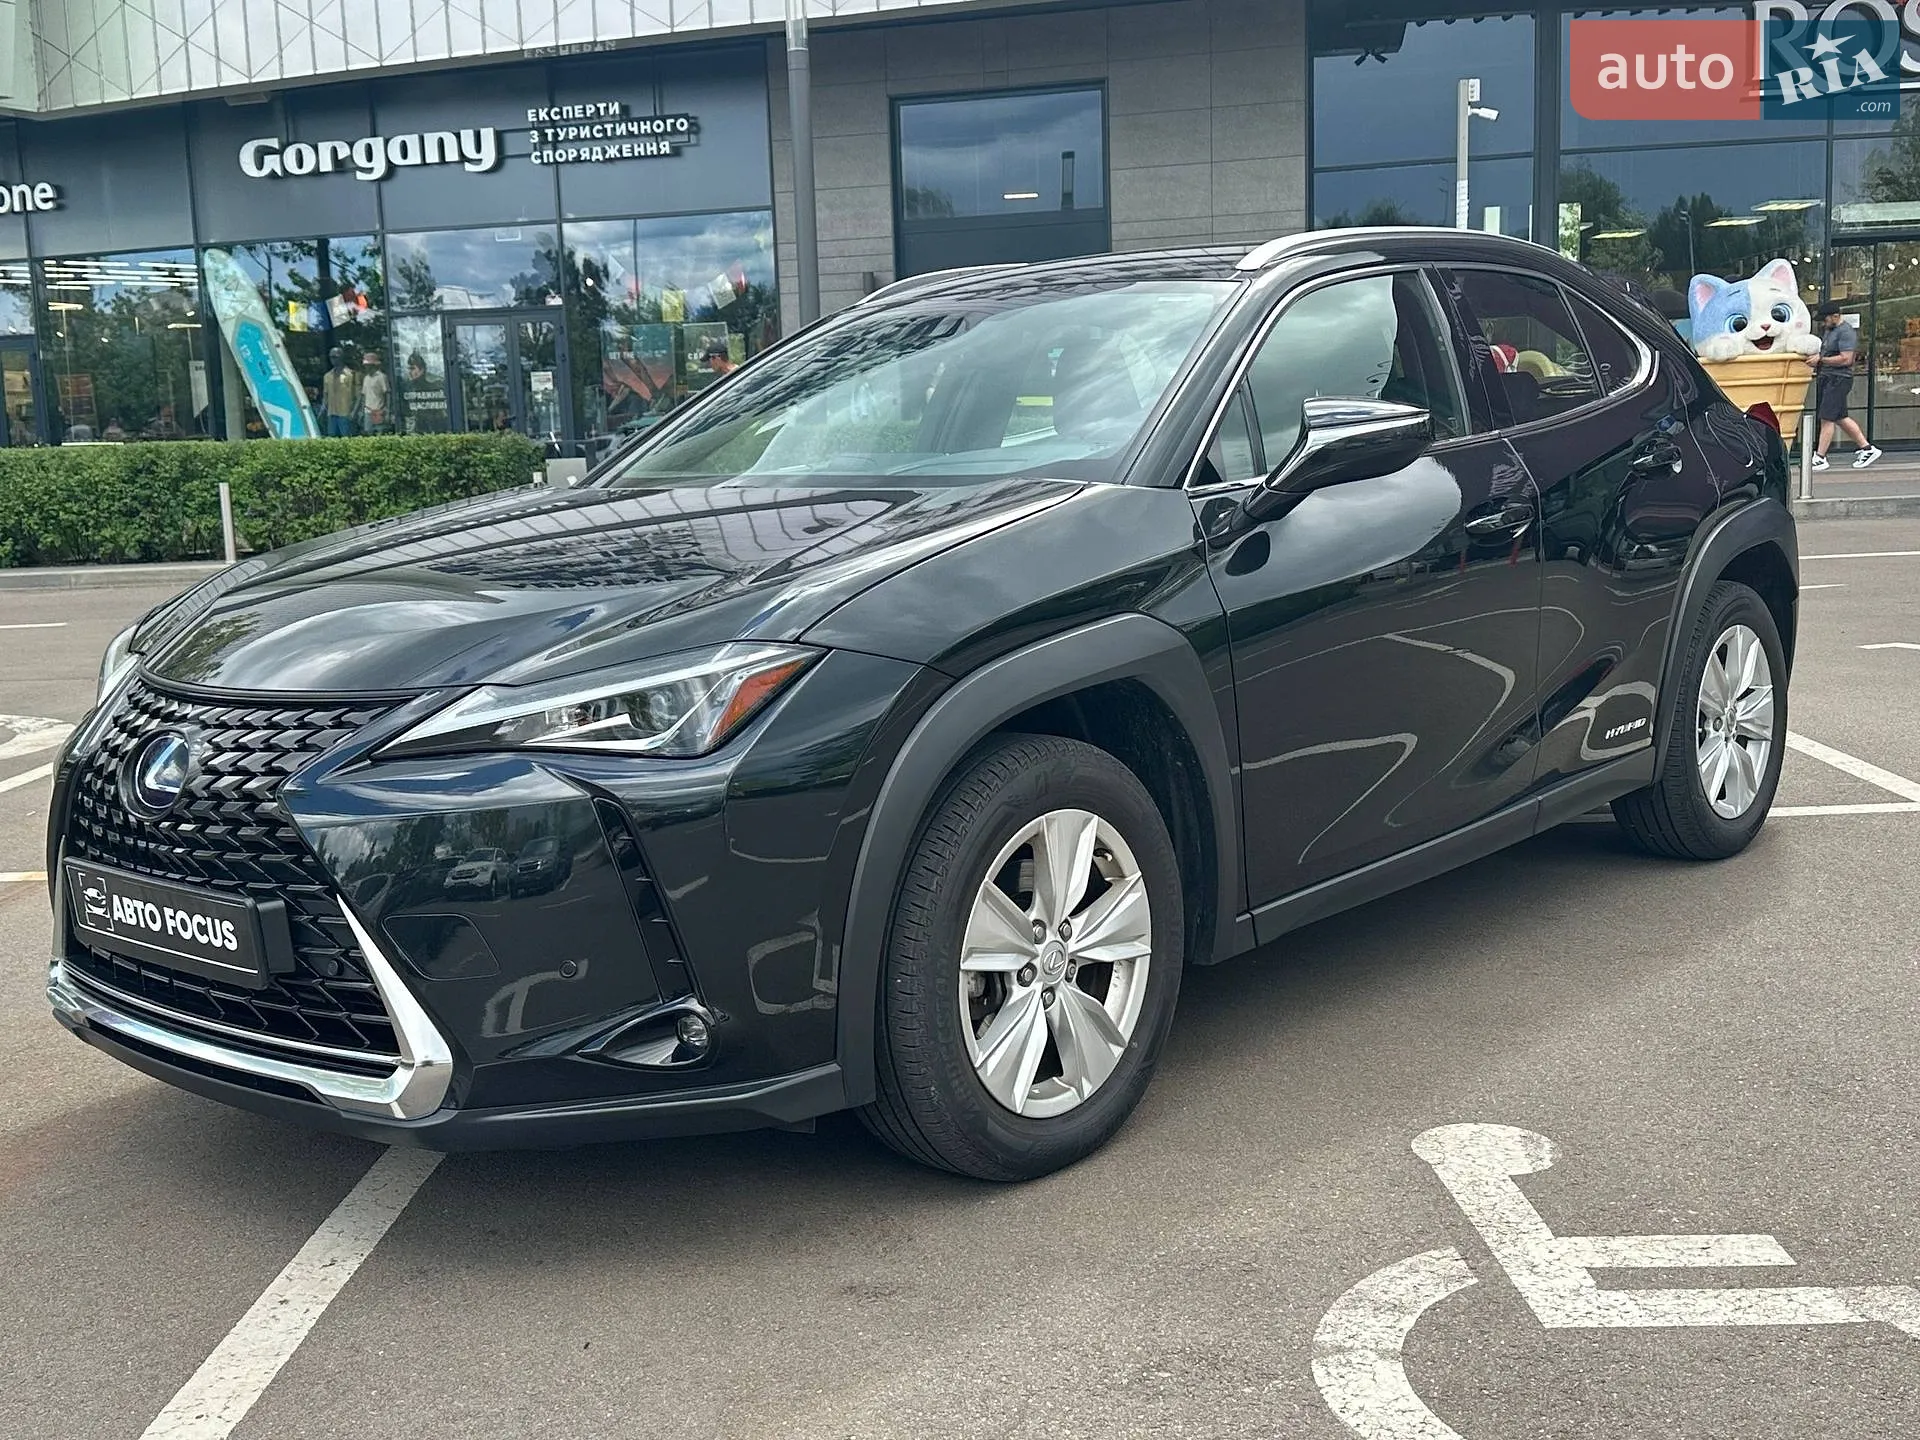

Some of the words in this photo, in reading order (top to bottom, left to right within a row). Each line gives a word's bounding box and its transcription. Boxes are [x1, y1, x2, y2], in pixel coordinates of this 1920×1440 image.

[527, 102, 620, 122] ЕКСПЕРТИ
[545, 117, 689, 142] ТУРИСТИЧНОГО
[239, 126, 498, 181] Gorgany
[530, 140, 671, 164] СПОРЯДЖЕННЯ
[163, 906, 239, 951] FOCUS
